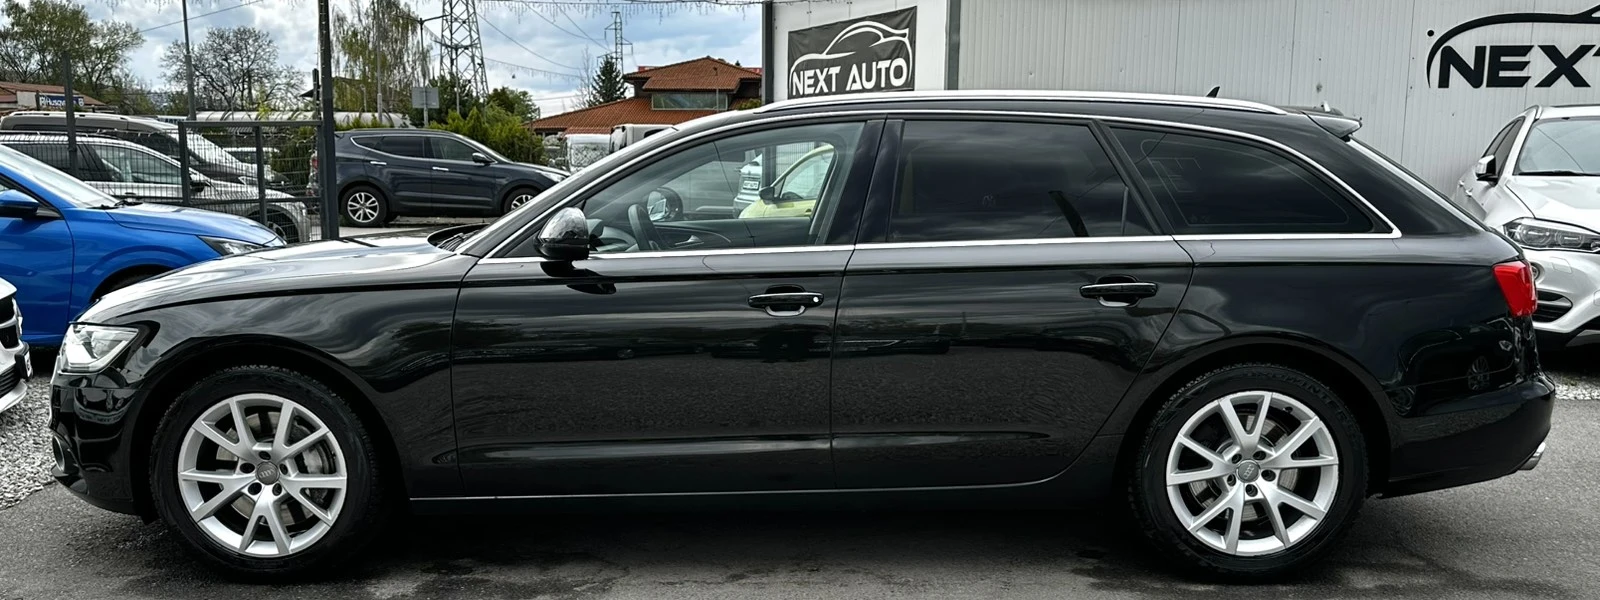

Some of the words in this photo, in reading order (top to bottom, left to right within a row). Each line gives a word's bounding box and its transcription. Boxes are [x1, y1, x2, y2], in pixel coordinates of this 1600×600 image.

[793, 66, 841, 95] NEXT
[845, 58, 908, 91] AUTO
[1438, 44, 1600, 89] NEX
